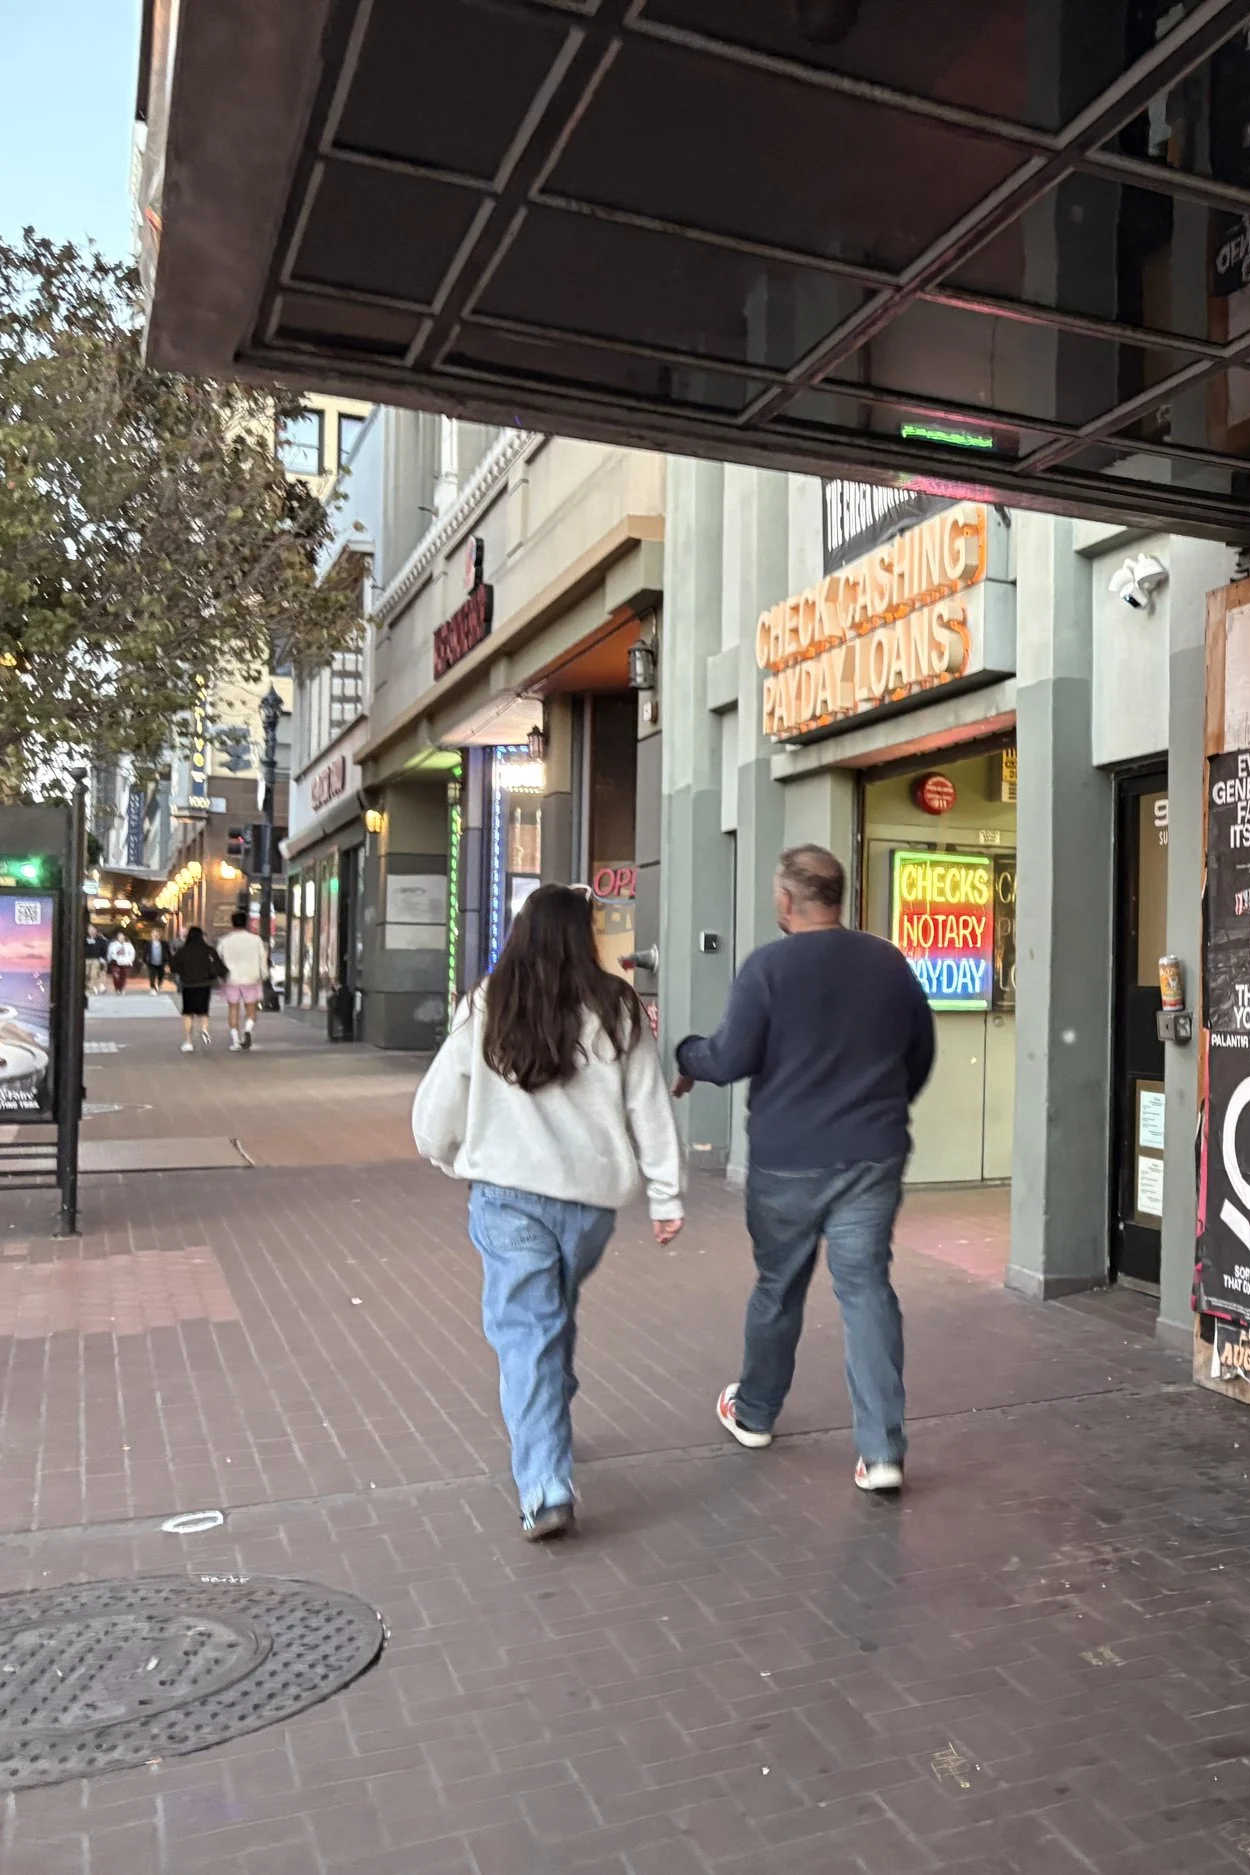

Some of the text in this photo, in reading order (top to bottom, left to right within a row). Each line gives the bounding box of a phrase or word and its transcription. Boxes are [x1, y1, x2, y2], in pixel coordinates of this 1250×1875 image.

[756, 577, 837, 669] CHECK
[837, 506, 968, 631] CASHING
[763, 604, 952, 735] PAYDAY LOANS
[900, 864, 989, 905] CHECKS
[903, 913, 986, 949] NOTARY
[906, 957, 985, 994] AYDAY
[1211, 1033, 1248, 1049] PALANTIR
[1223, 1273, 1243, 1290] THAT
